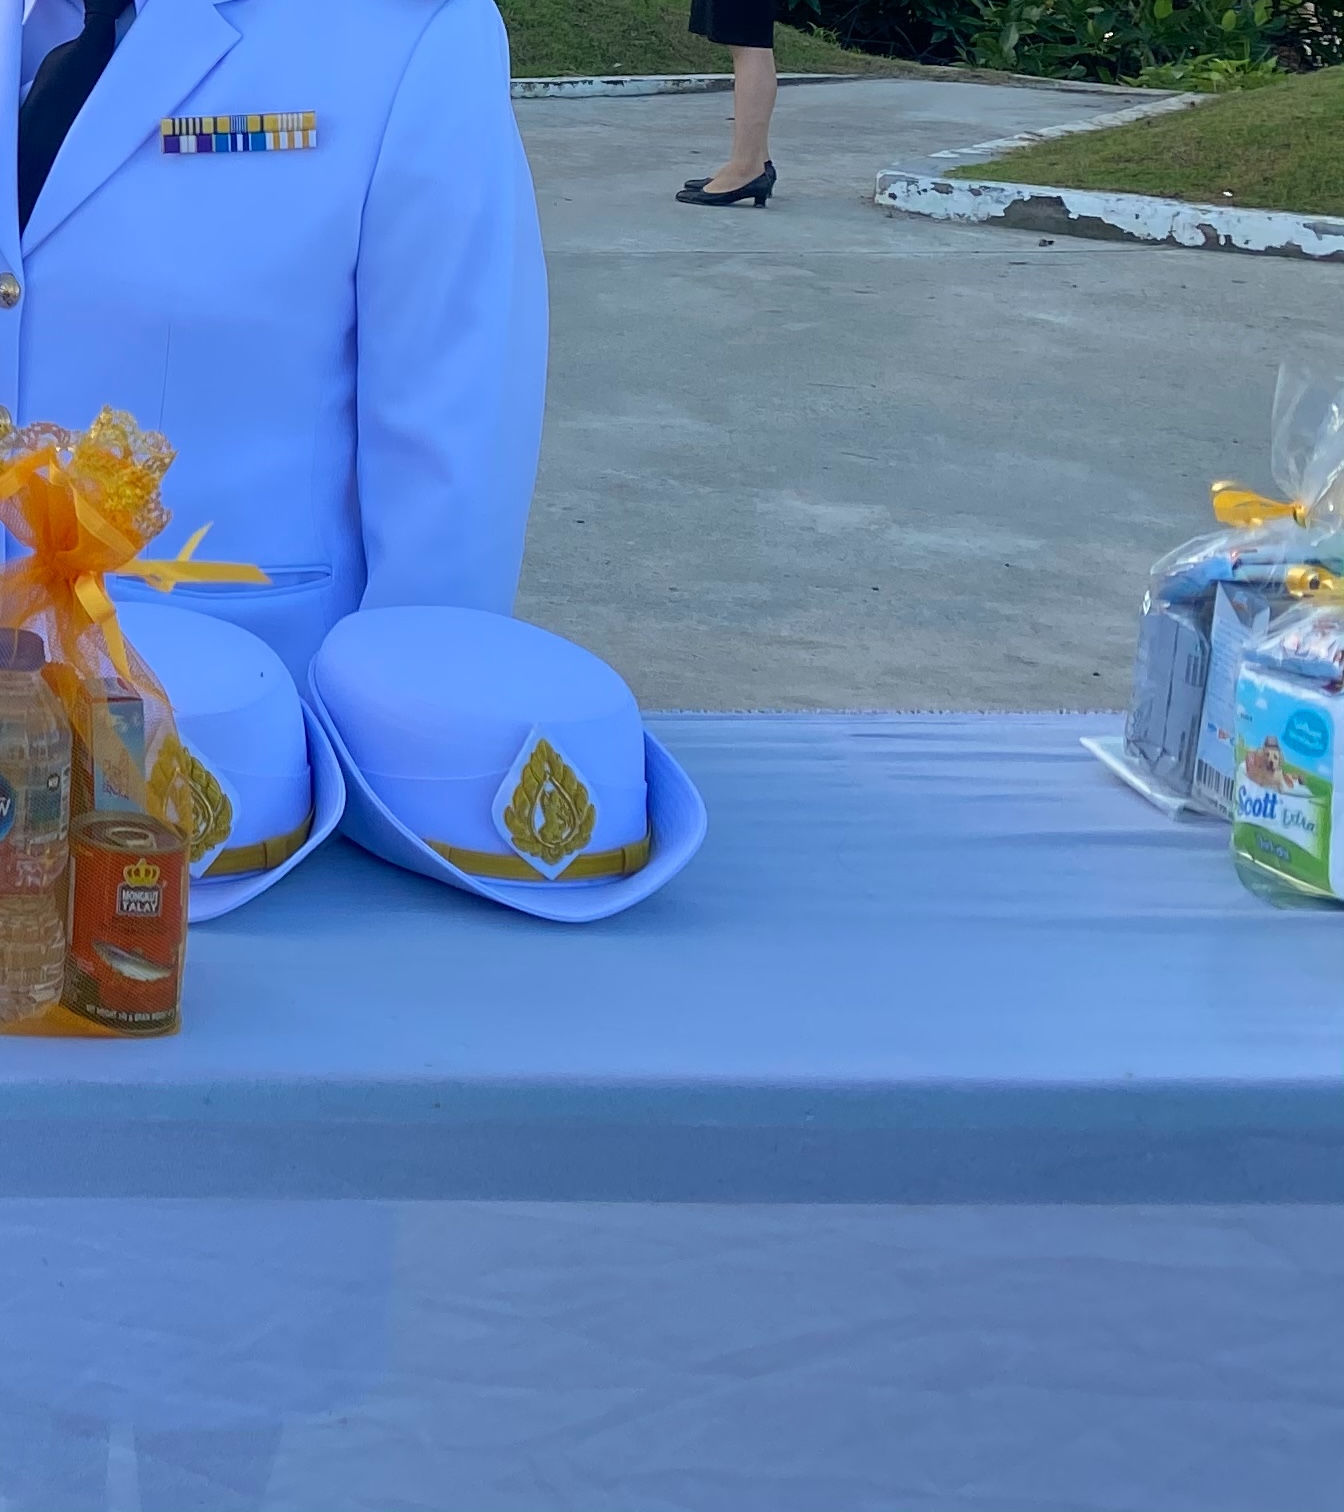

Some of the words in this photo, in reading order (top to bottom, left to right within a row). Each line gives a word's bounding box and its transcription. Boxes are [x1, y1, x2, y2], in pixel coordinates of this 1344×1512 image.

[1237, 785, 1277, 819] Scott
[122, 890, 158, 903] MONGKUT
[122, 901, 158, 913] TALAY
